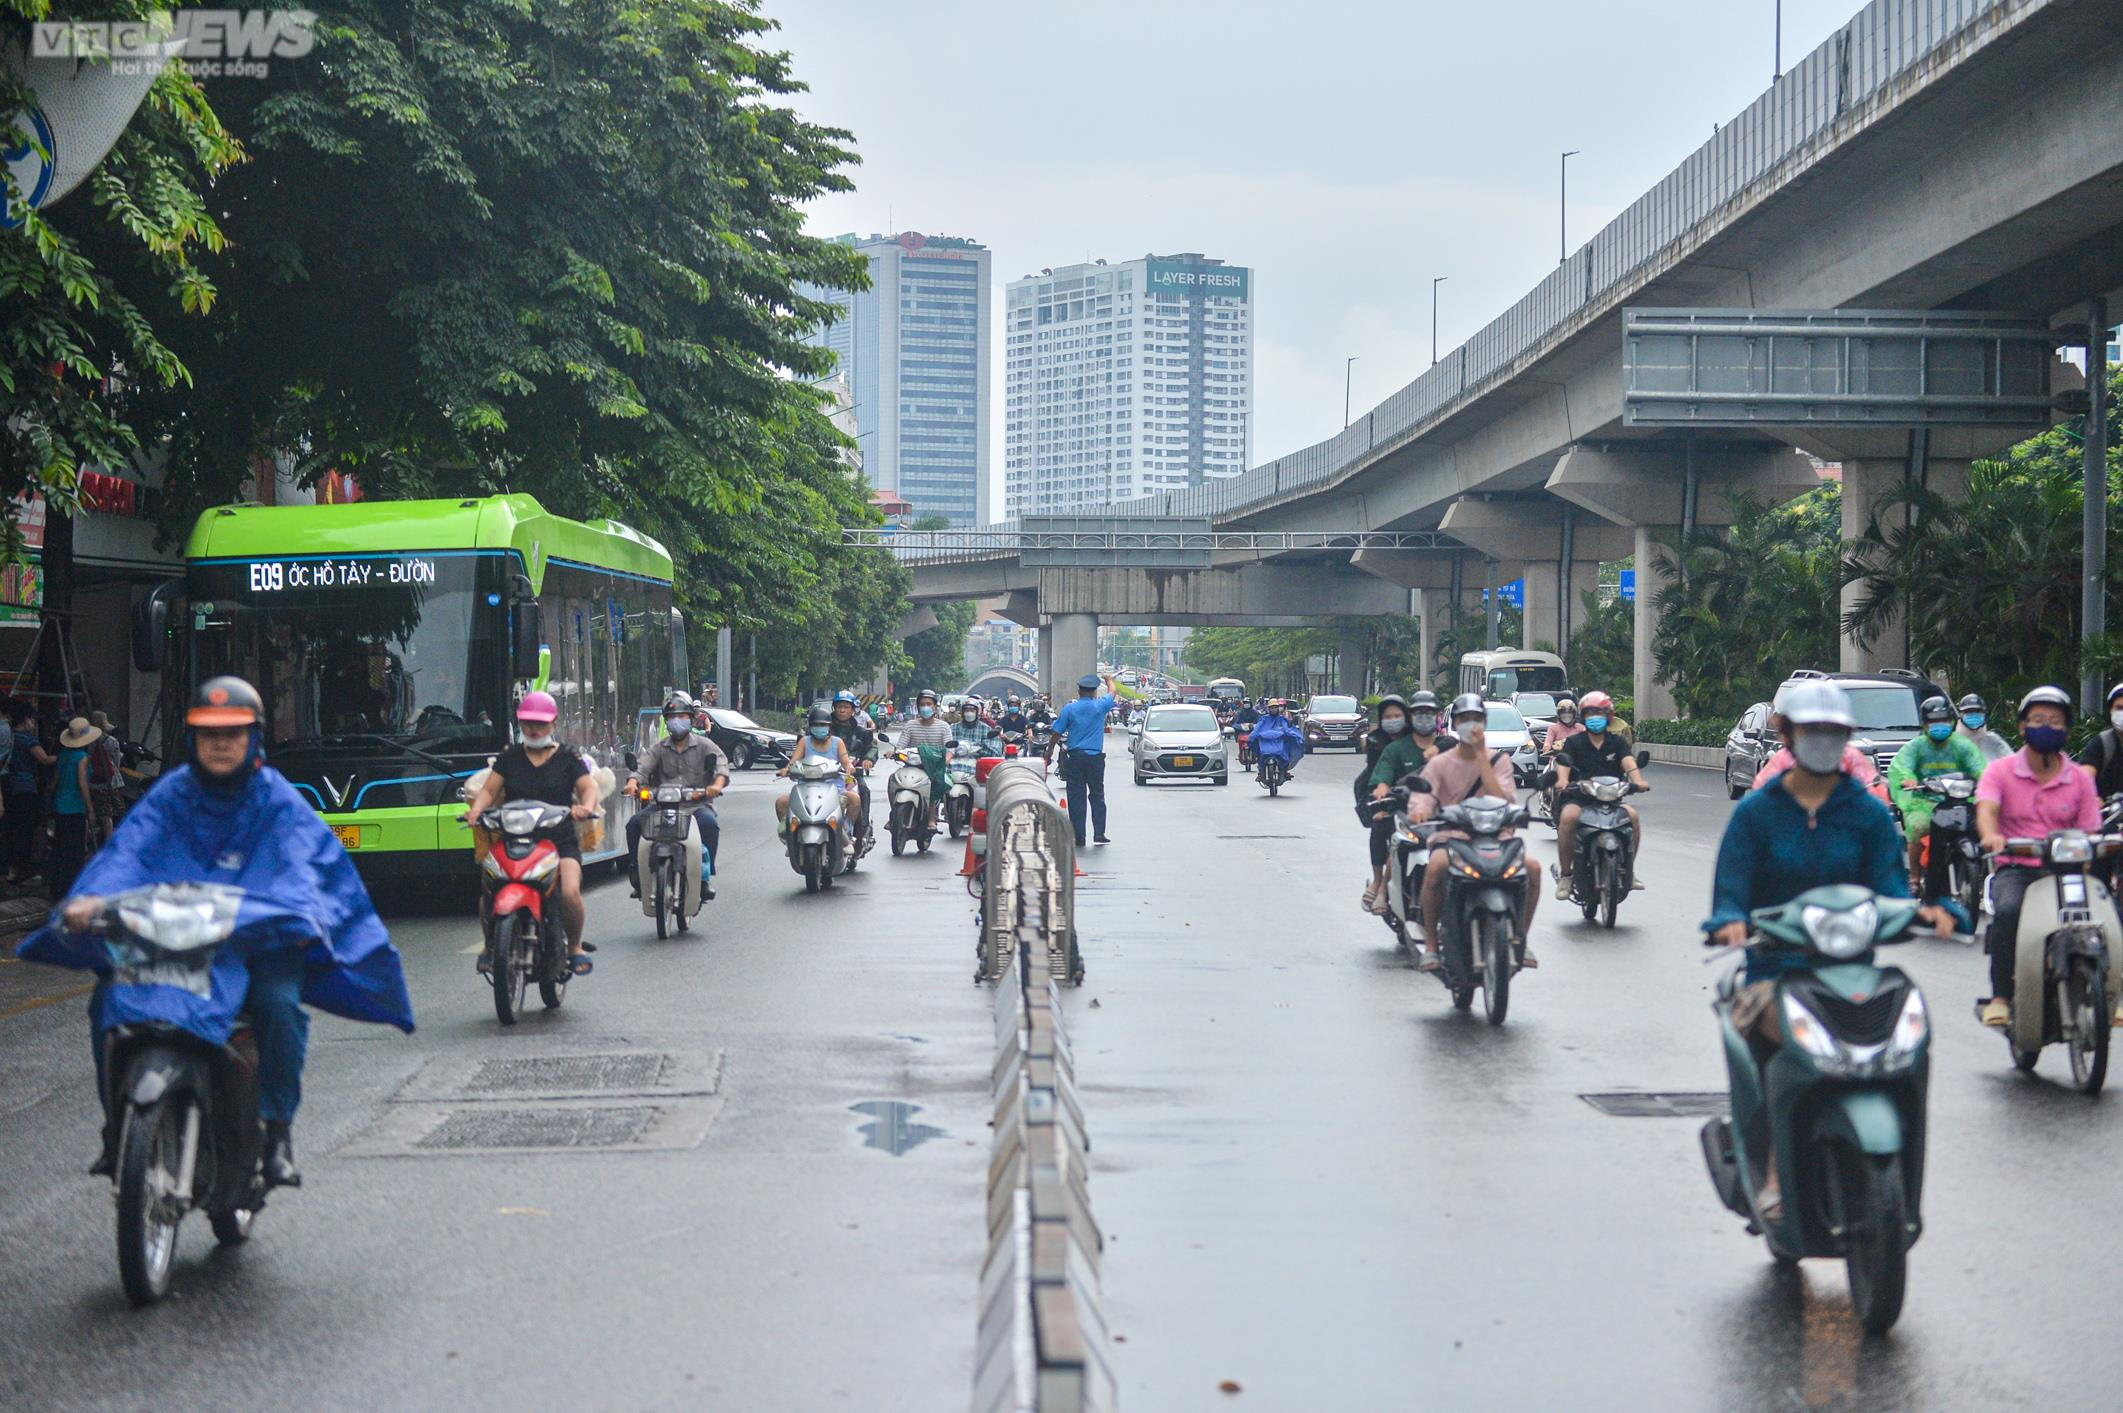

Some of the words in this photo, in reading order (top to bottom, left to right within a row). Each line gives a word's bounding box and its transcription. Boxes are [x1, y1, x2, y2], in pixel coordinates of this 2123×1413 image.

[1153, 271, 1195, 286] LAYER
[1199, 273, 1241, 287] FRESH
[250, 562, 283, 592] E09
[313, 560, 335, 586] HỒ
[338, 560, 371, 585] TÂY
[389, 558, 435, 583] ĐƯỜN
